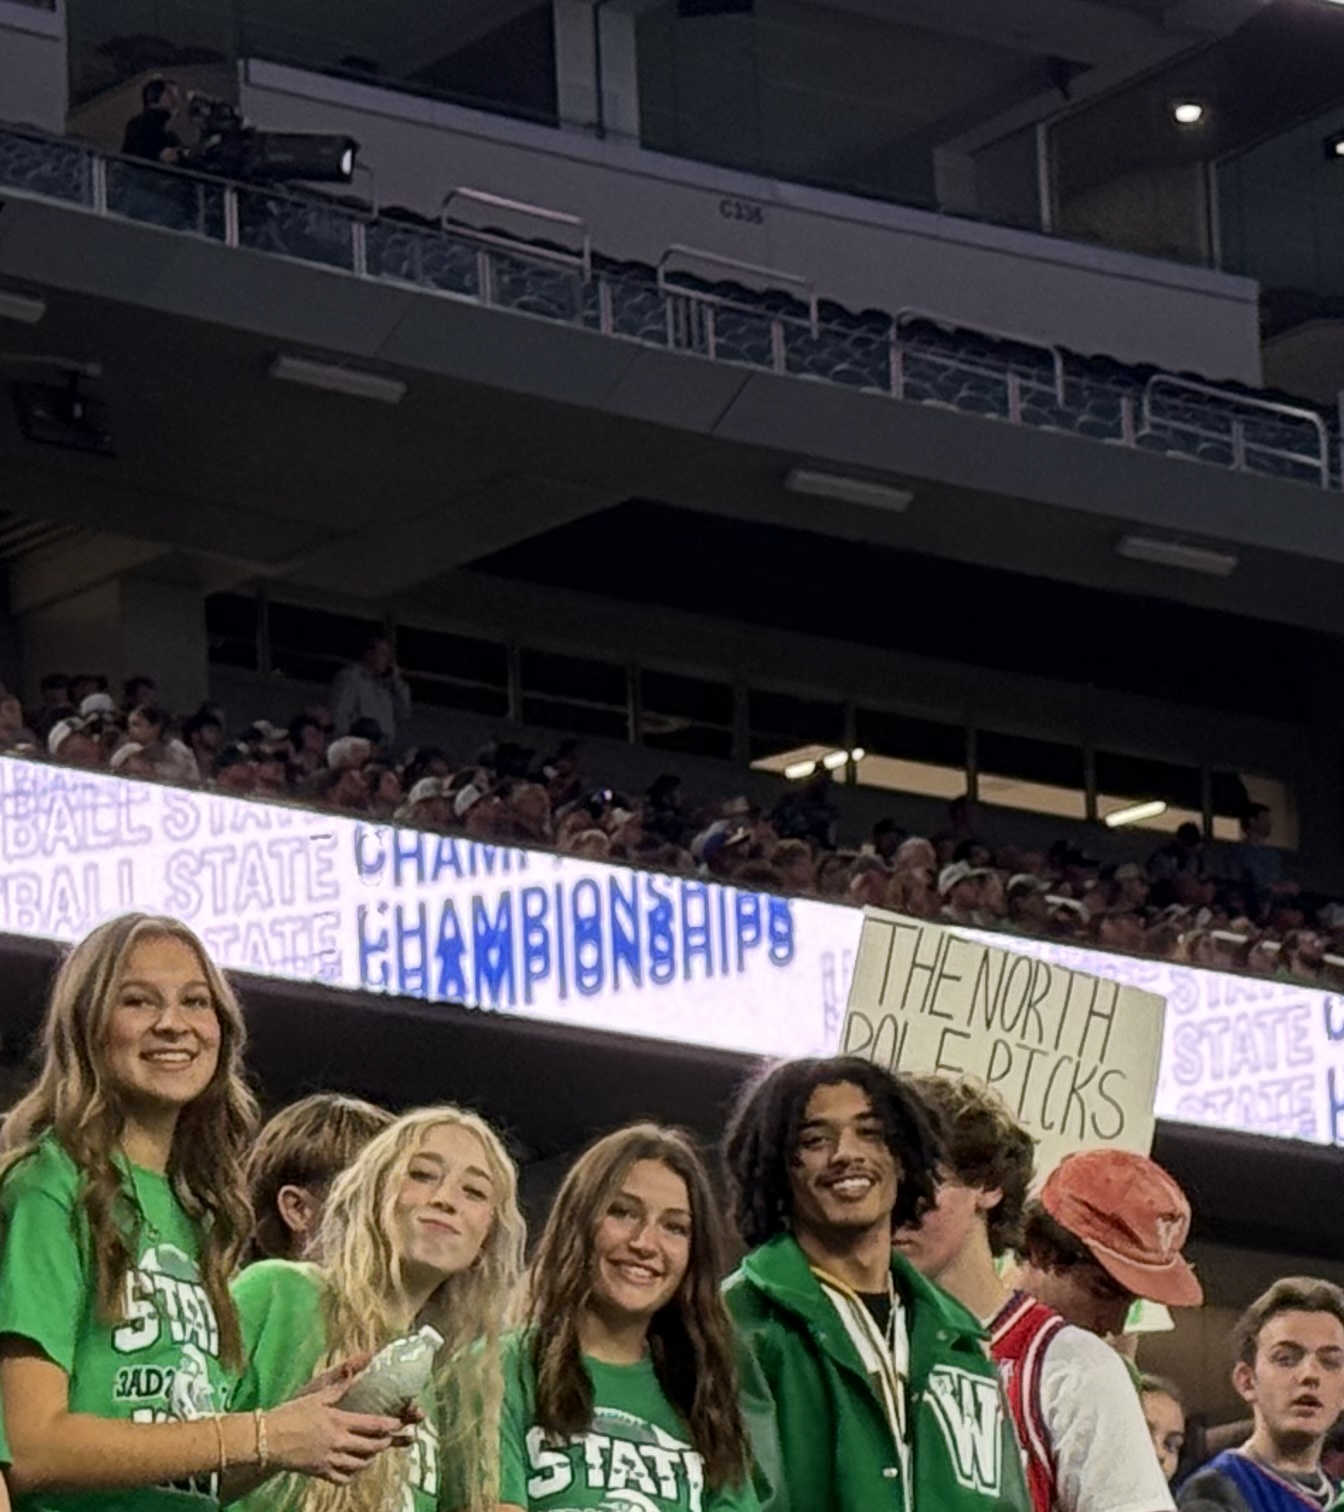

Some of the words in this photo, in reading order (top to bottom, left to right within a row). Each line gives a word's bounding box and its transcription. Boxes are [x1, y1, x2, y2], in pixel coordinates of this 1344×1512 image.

[162, 832, 342, 922] STATE
[867, 914, 971, 1021] THE
[966, 944, 1121, 1064] NORTH
[986, 1037, 1128, 1141] PICKS
[1171, 1001, 1316, 1087] STATE
[922, 1363, 1002, 1498] W
